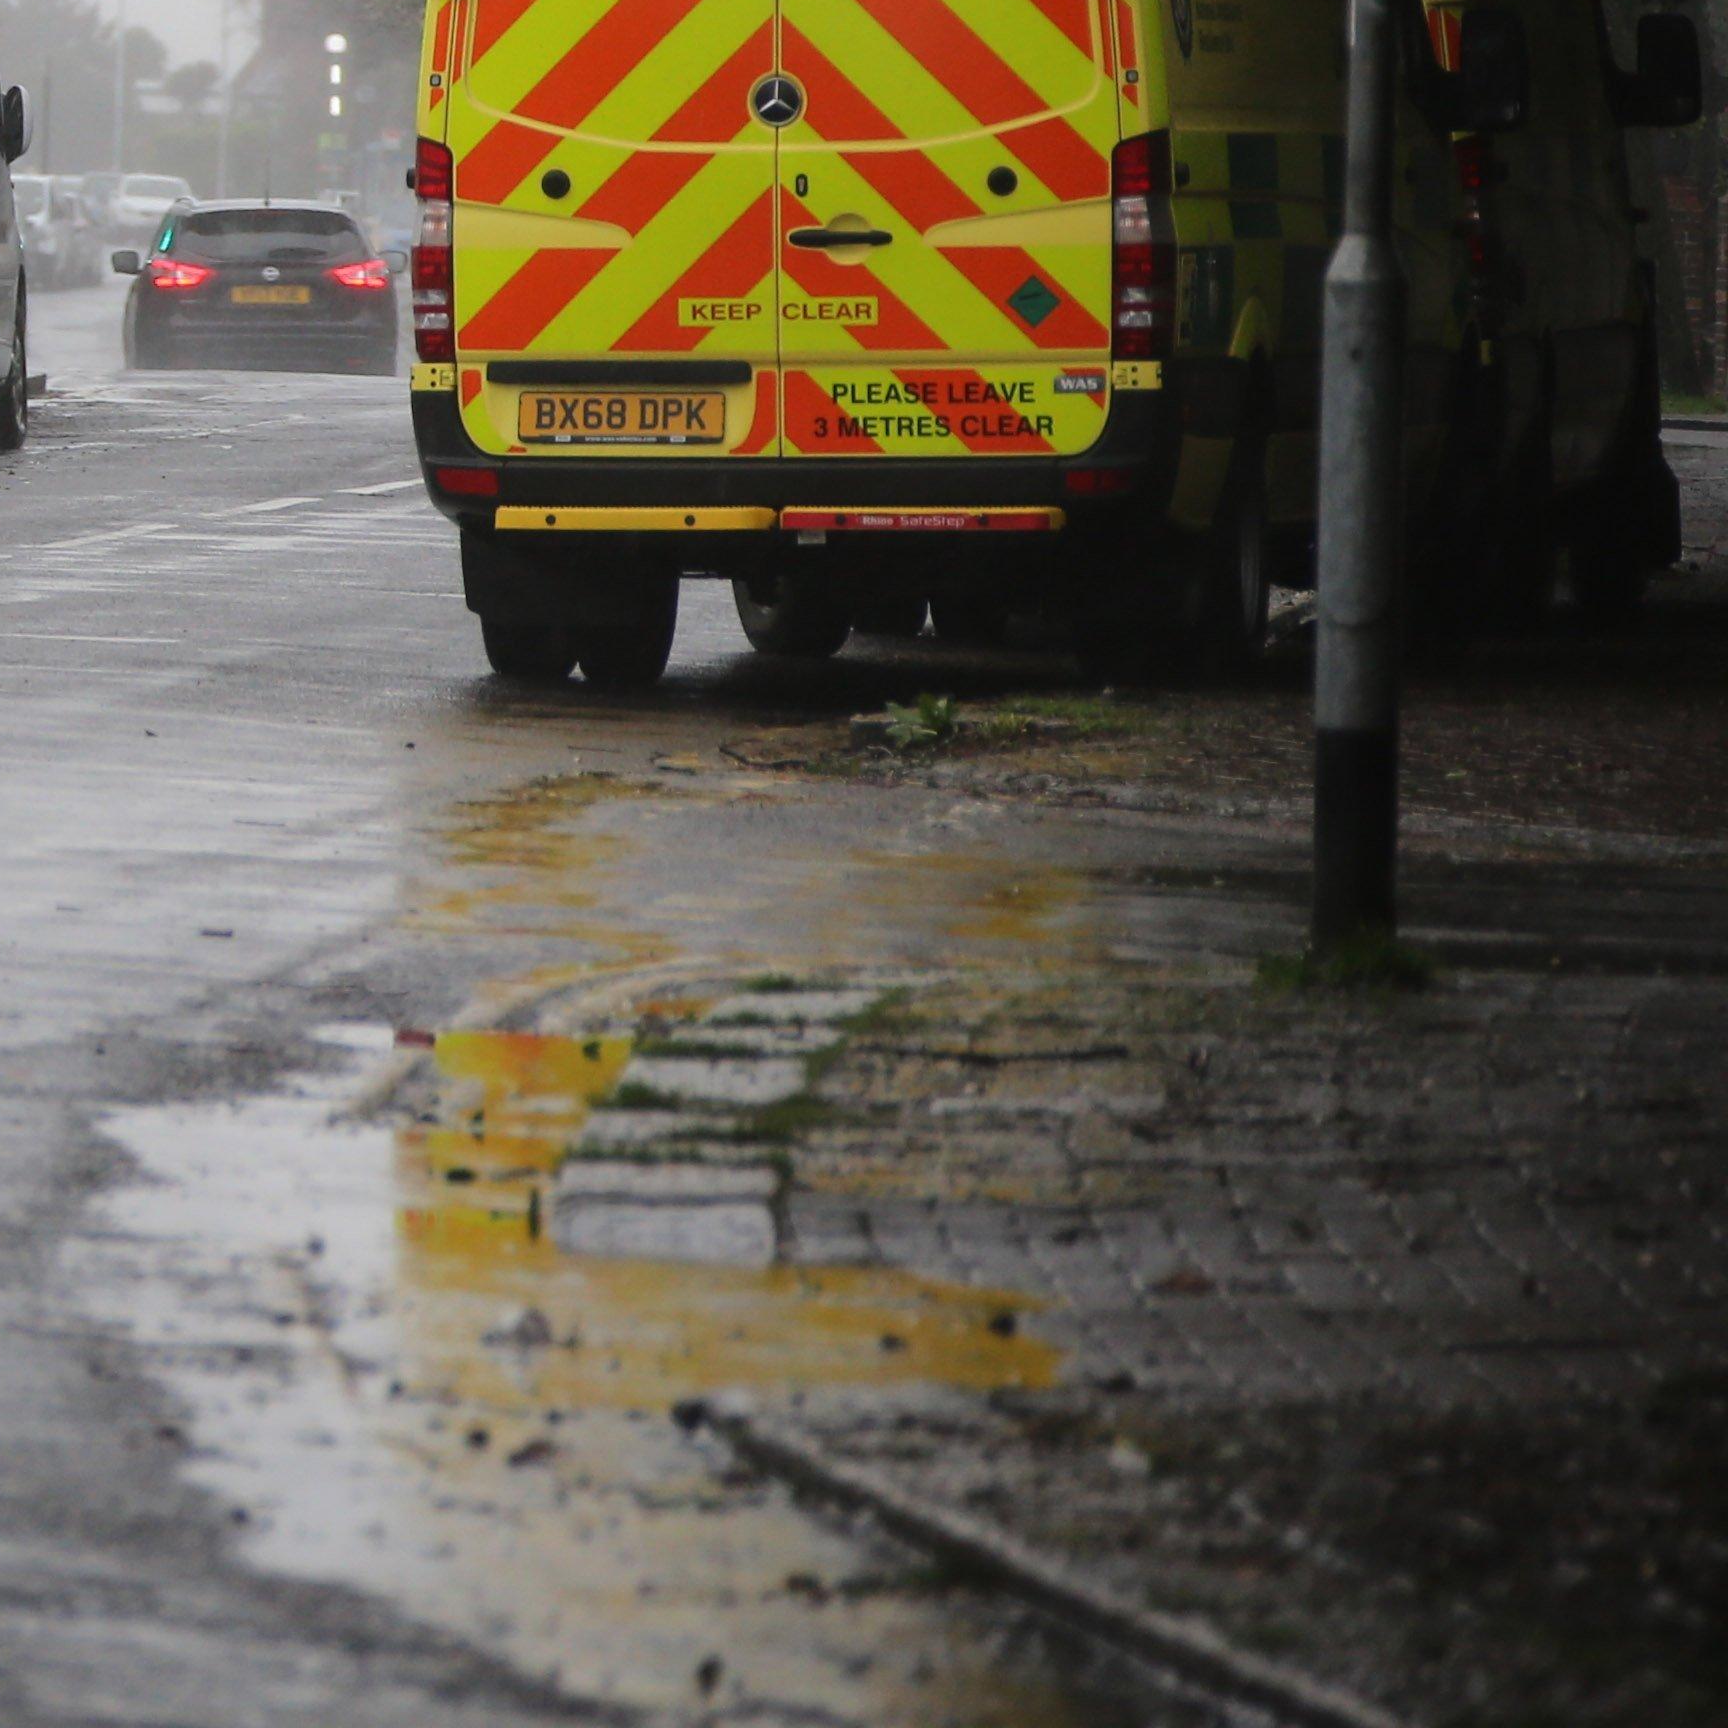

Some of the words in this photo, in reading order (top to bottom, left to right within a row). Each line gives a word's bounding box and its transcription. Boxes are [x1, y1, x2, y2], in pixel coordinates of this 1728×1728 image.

[691, 303, 762, 320] KEEP
[782, 302, 872, 320] CLEAR
[832, 381, 940, 404] PLEASE
[946, 381, 1035, 404] LEAVE
[1059, 377, 1099, 390] WAS
[534, 398, 627, 430] BX68
[638, 398, 707, 430] DPK
[814, 417, 828, 437] 3
[838, 416, 952, 437] METRES
[960, 415, 1055, 437] CLEAR
[899, 515, 965, 528] SafeStep
